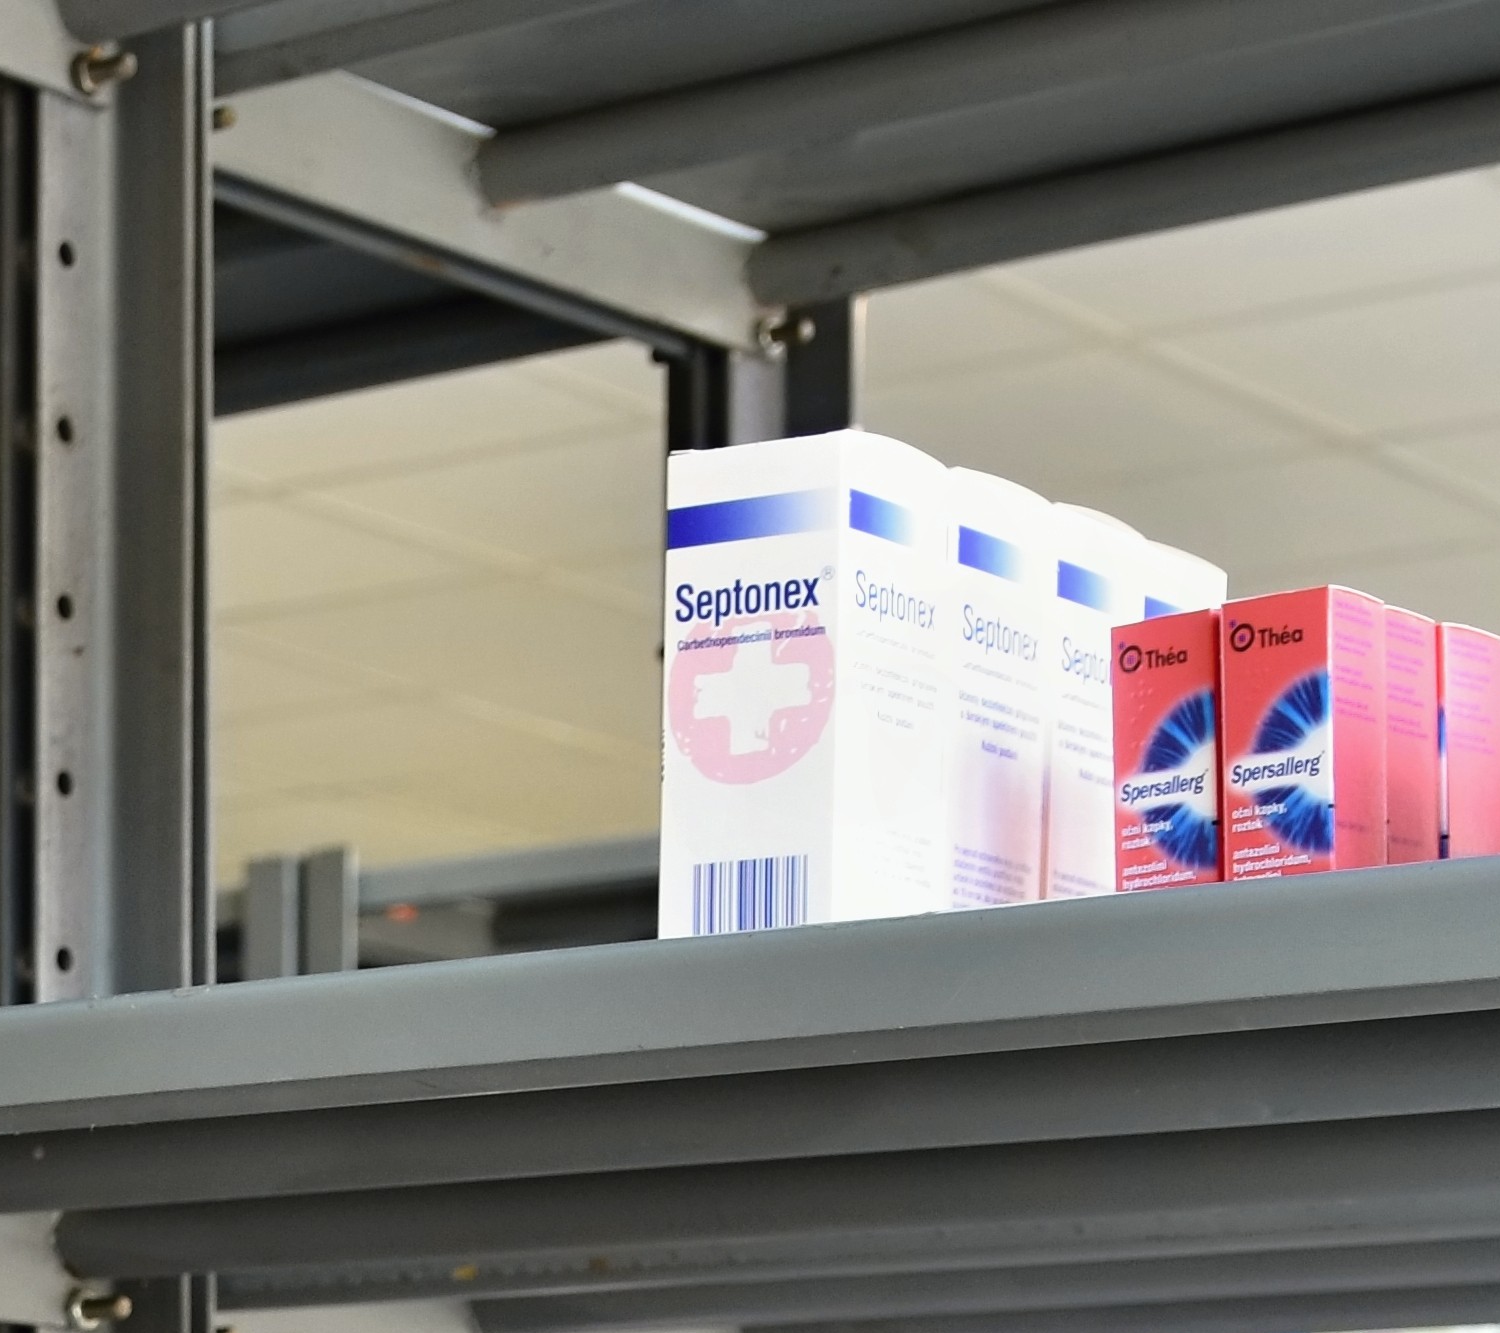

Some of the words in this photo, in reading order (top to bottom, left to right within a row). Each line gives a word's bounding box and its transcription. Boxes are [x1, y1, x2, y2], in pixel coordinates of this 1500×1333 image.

[855, 570, 936, 630] Septonex
[773, 624, 826, 640] bromidum
[962, 603, 1038, 663] Septonex
[1258, 627, 1303, 648] Théa
[1146, 647, 1187, 669] Théa
[1231, 756, 1321, 787] Spersallerg
[1121, 772, 1204, 804] Spersallerg
